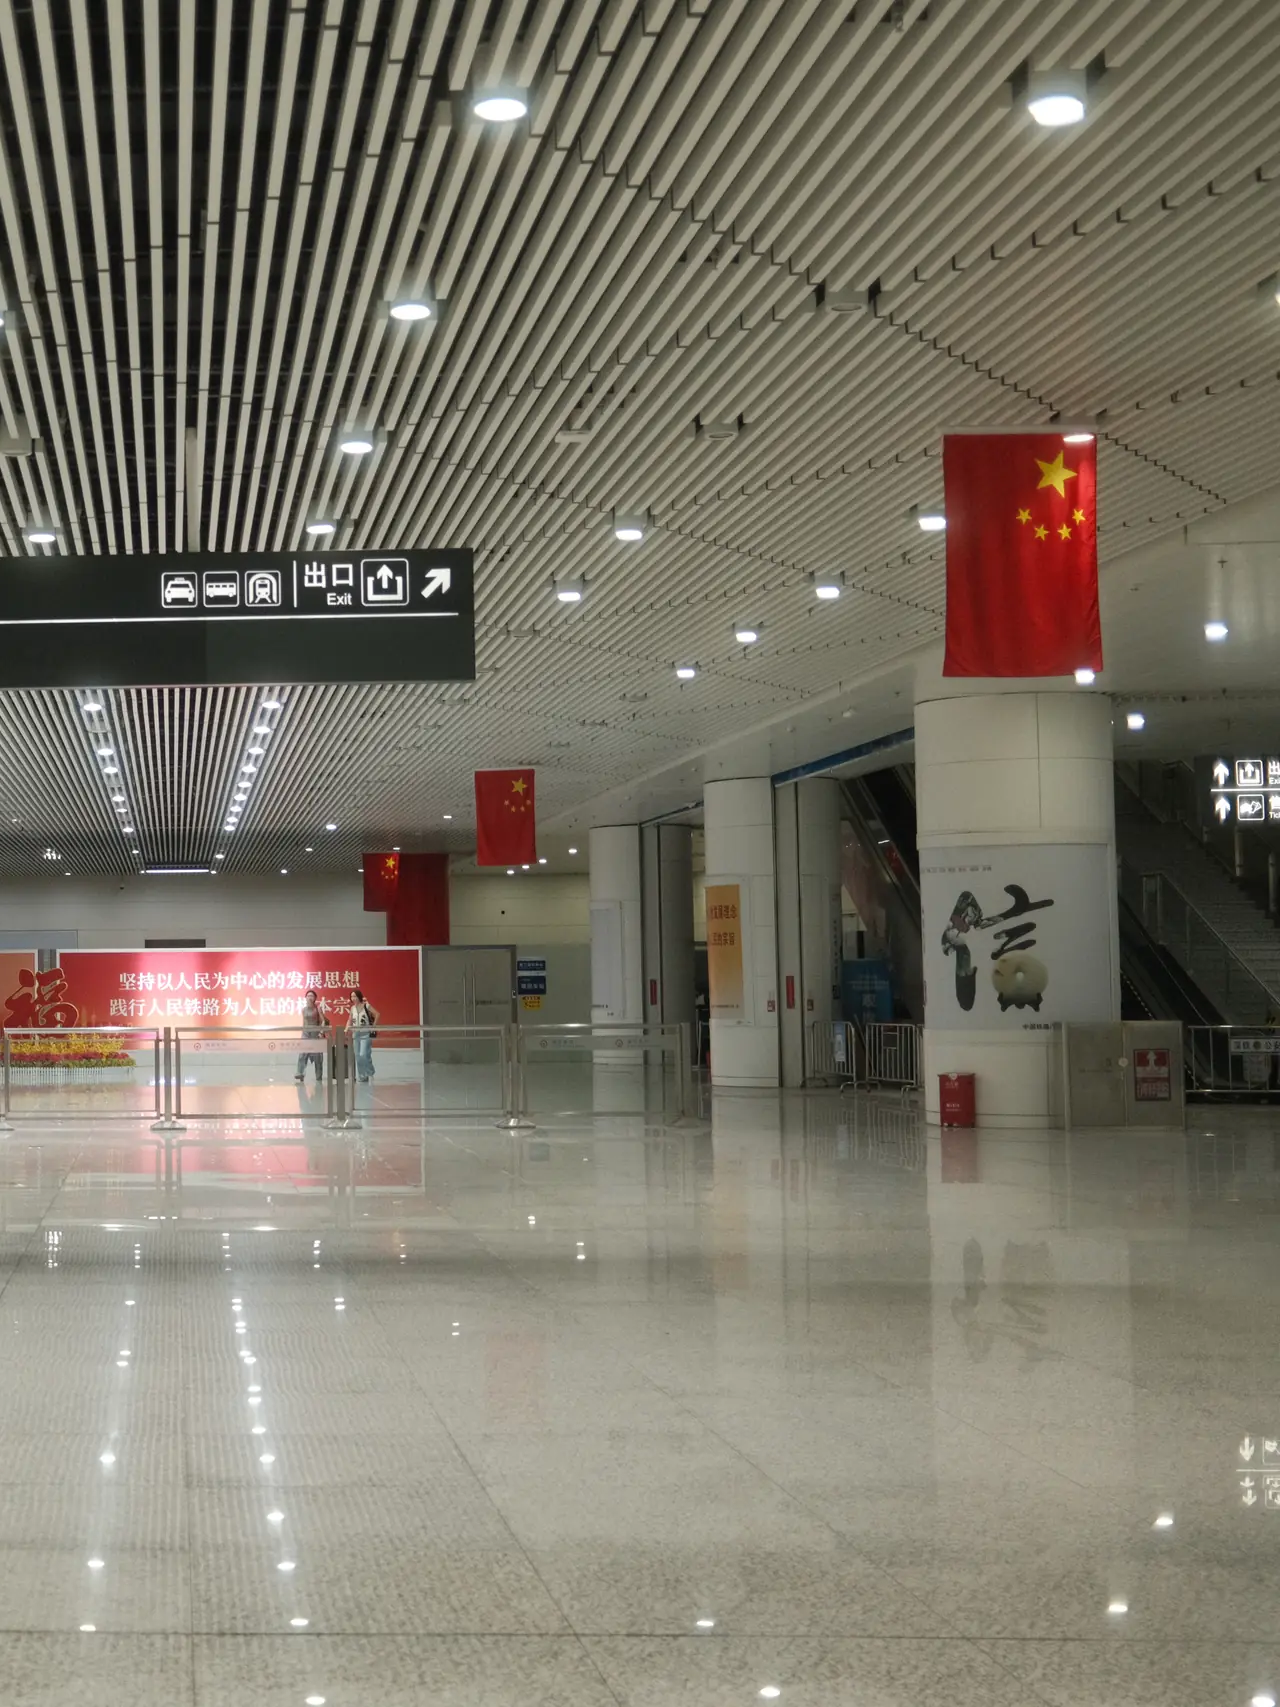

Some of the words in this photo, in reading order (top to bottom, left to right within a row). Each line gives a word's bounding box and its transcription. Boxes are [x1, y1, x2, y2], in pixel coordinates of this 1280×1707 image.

[304, 562, 354, 588] 出口
[326, 592, 353, 606] Exit
[119, 971, 361, 991] 坚持以人民为中心的发展思想
[109, 998, 368, 1017] 践行人民铁路为人民的本宗
